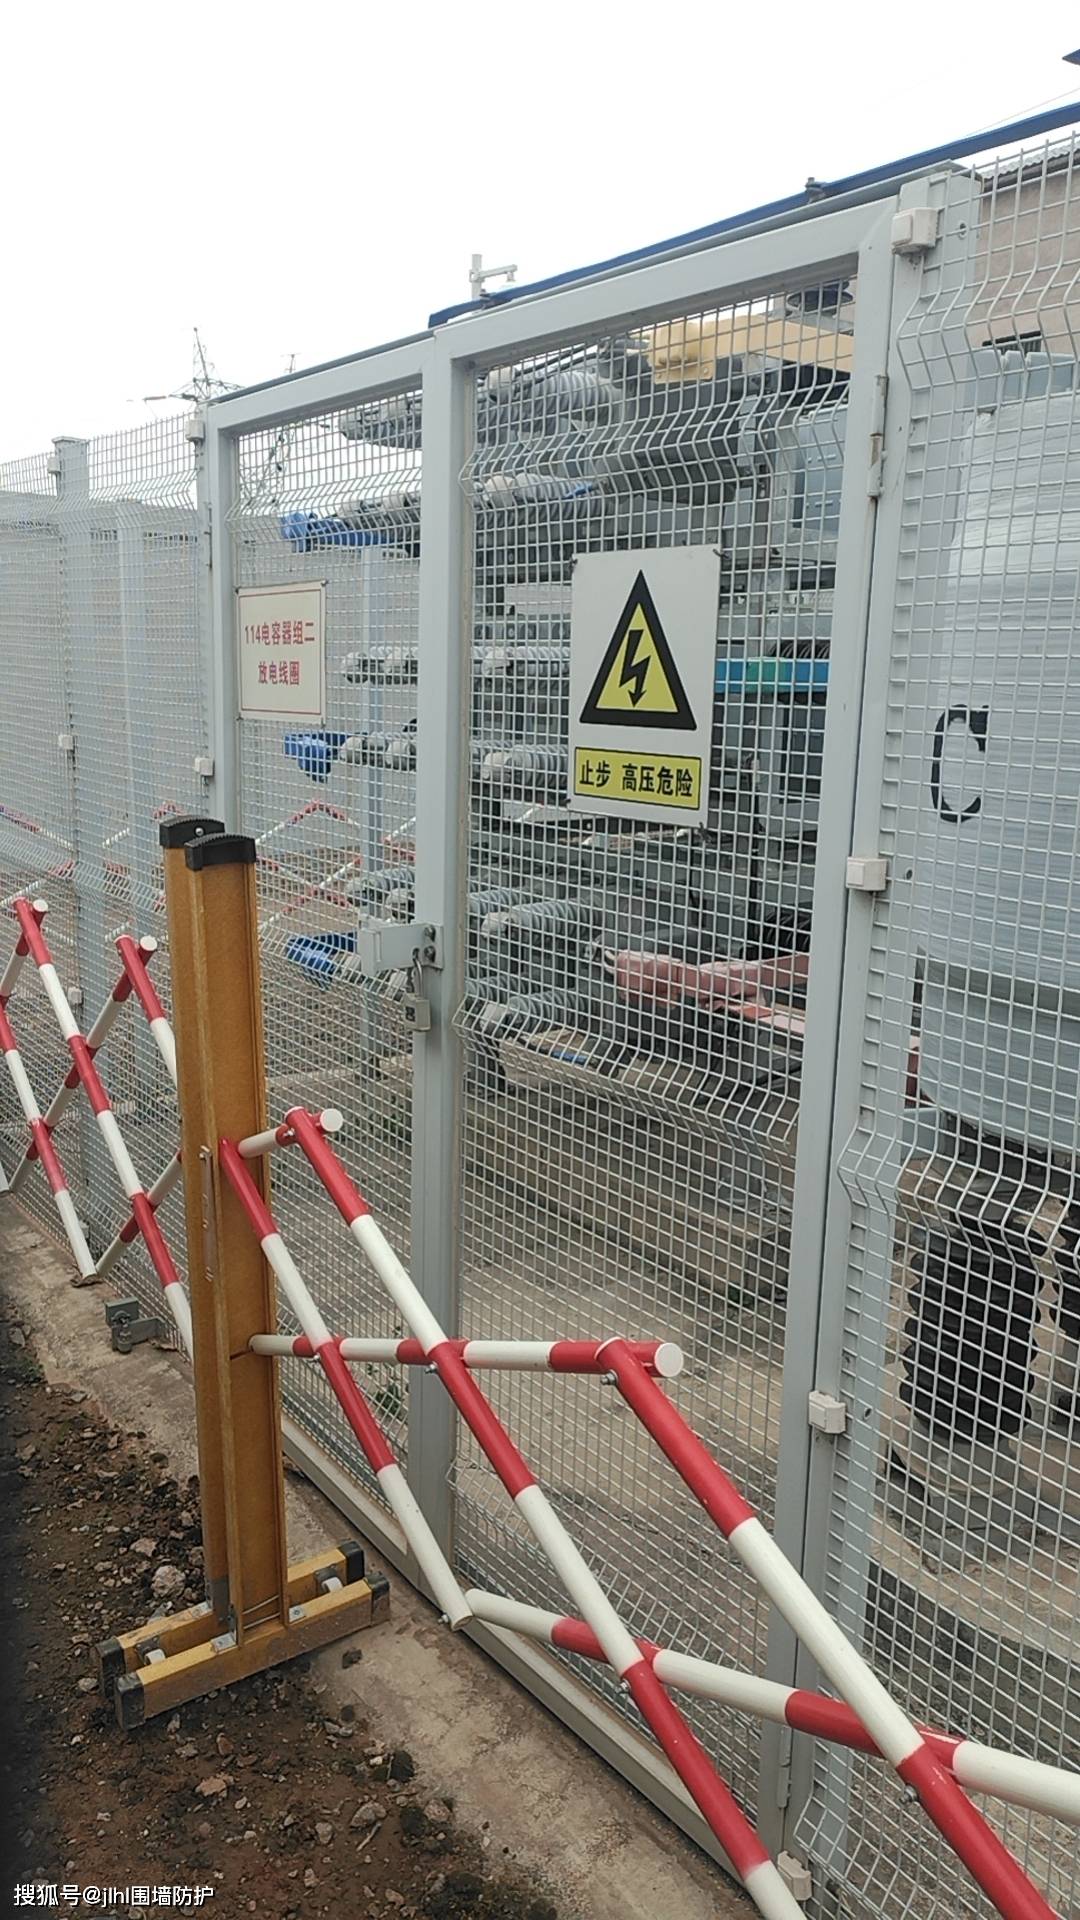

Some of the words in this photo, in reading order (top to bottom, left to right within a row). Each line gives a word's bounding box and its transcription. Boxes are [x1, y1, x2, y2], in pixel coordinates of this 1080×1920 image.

[244, 621, 315, 646] 114电容器组二
[258, 661, 300, 685] 放电线圈
[579, 759, 611, 788] 止步
[622, 763, 693, 797] 高压危险
[931, 704, 989, 823] C
